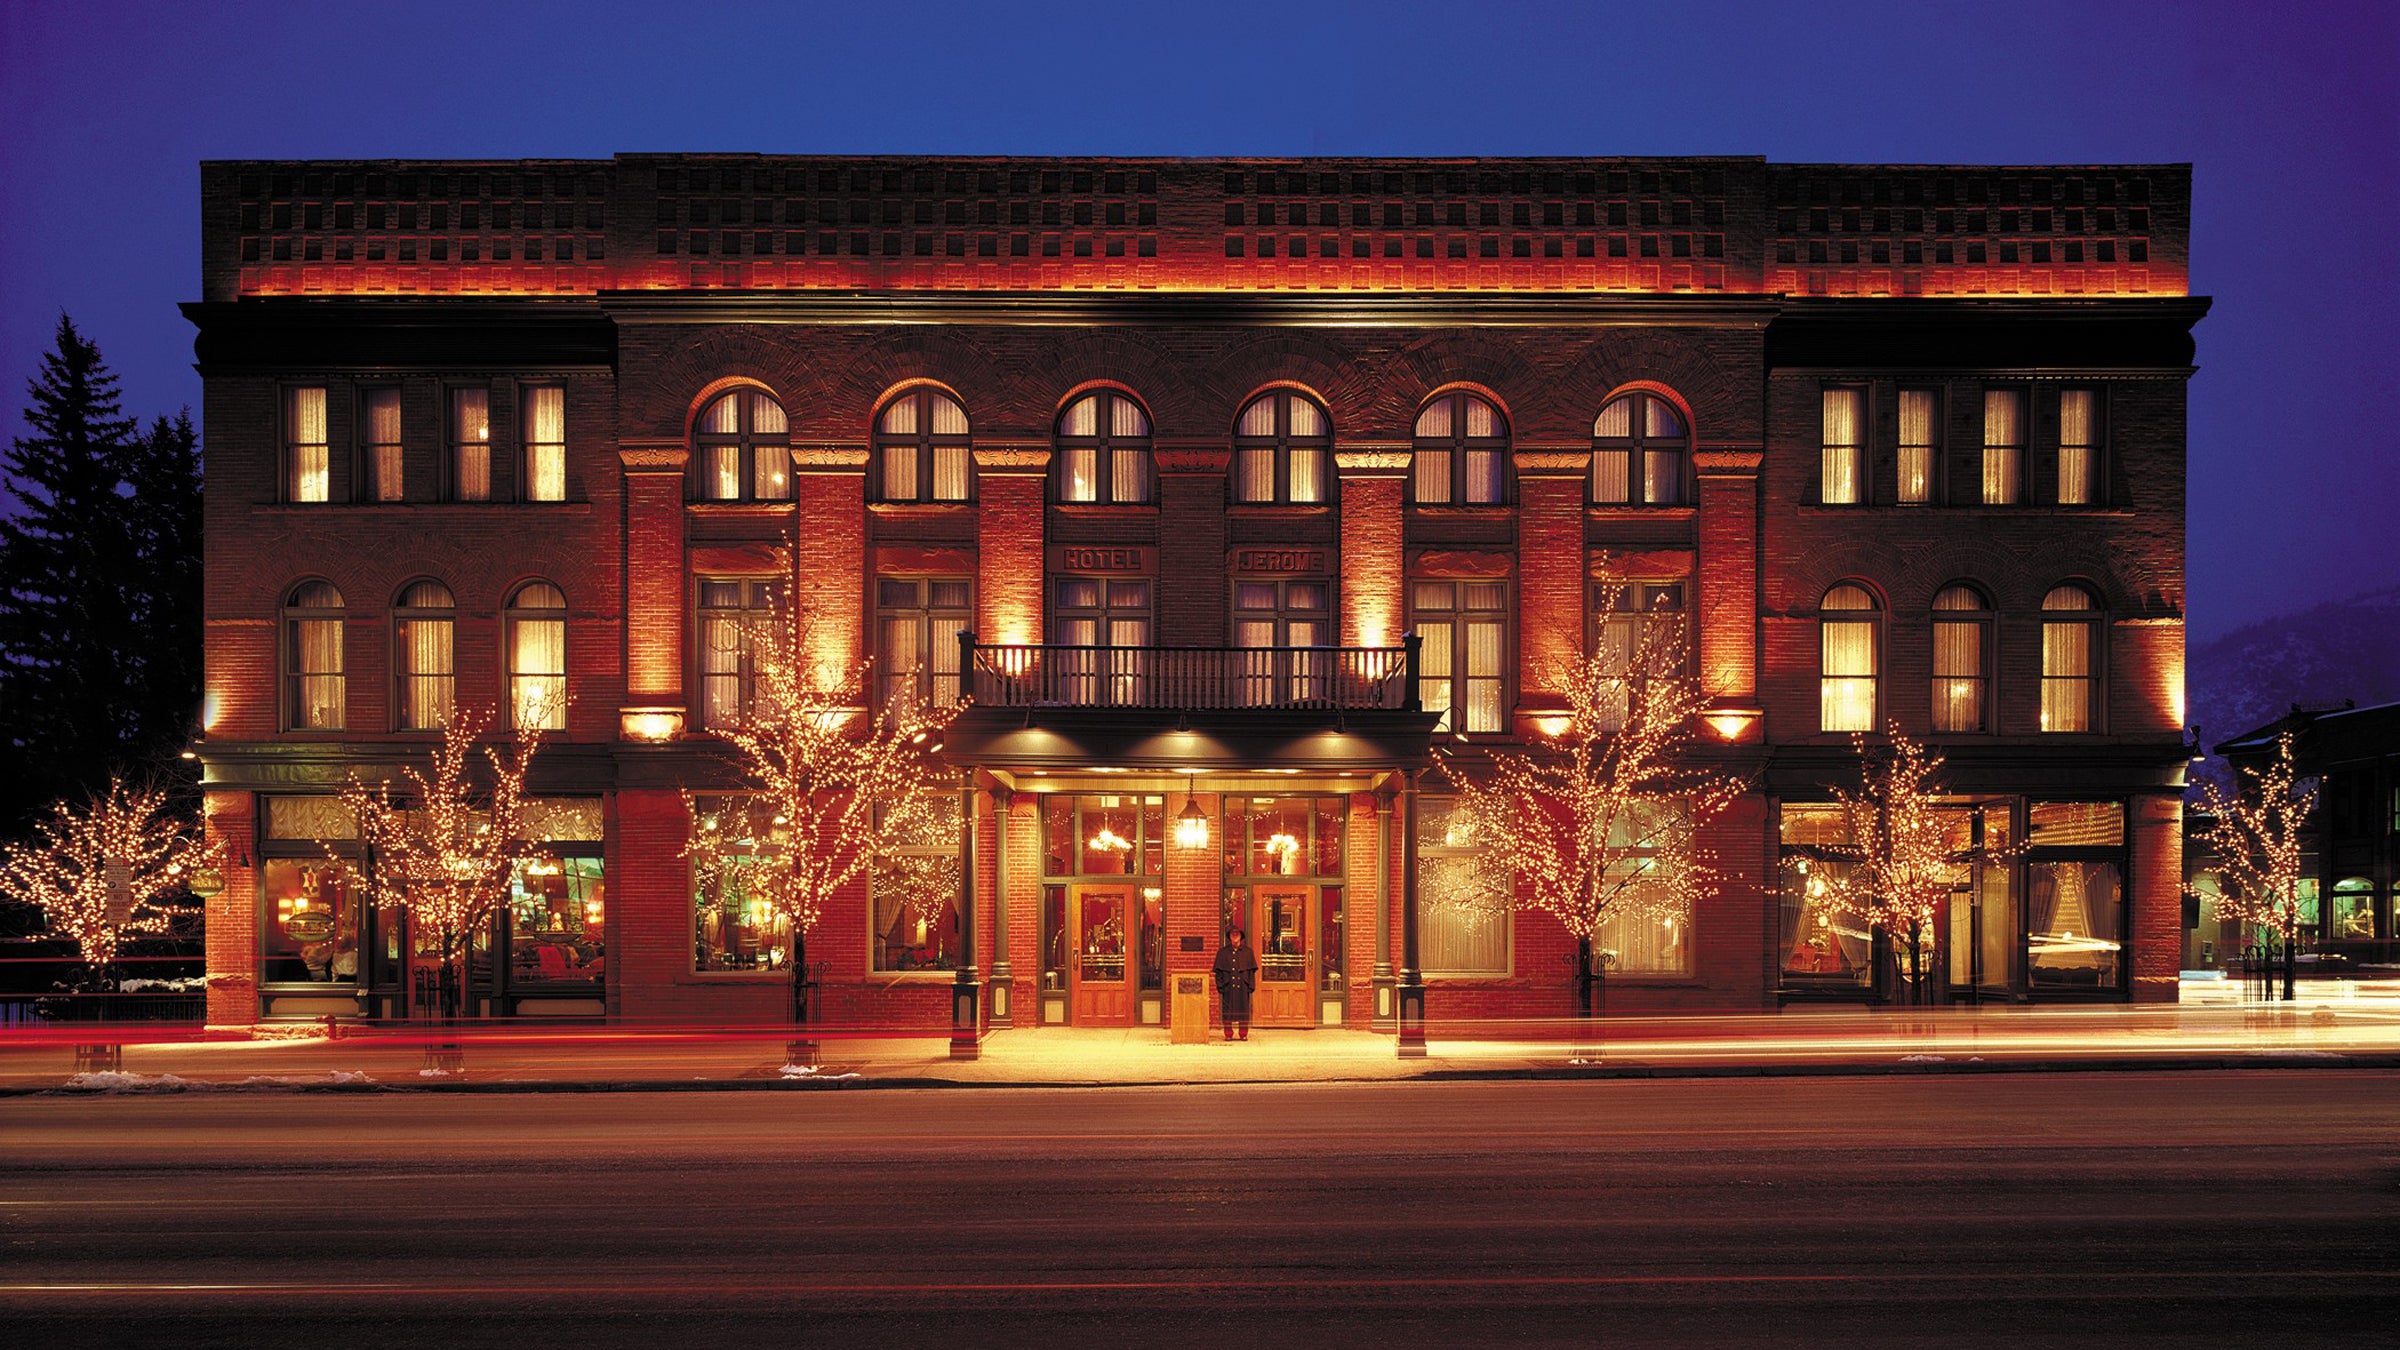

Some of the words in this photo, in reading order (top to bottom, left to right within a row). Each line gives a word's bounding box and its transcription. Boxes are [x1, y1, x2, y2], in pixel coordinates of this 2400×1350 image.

[1065, 550, 1140, 569] HOTEL
[1239, 552, 1324, 571] JEROME
[112, 893, 123, 901] NO
